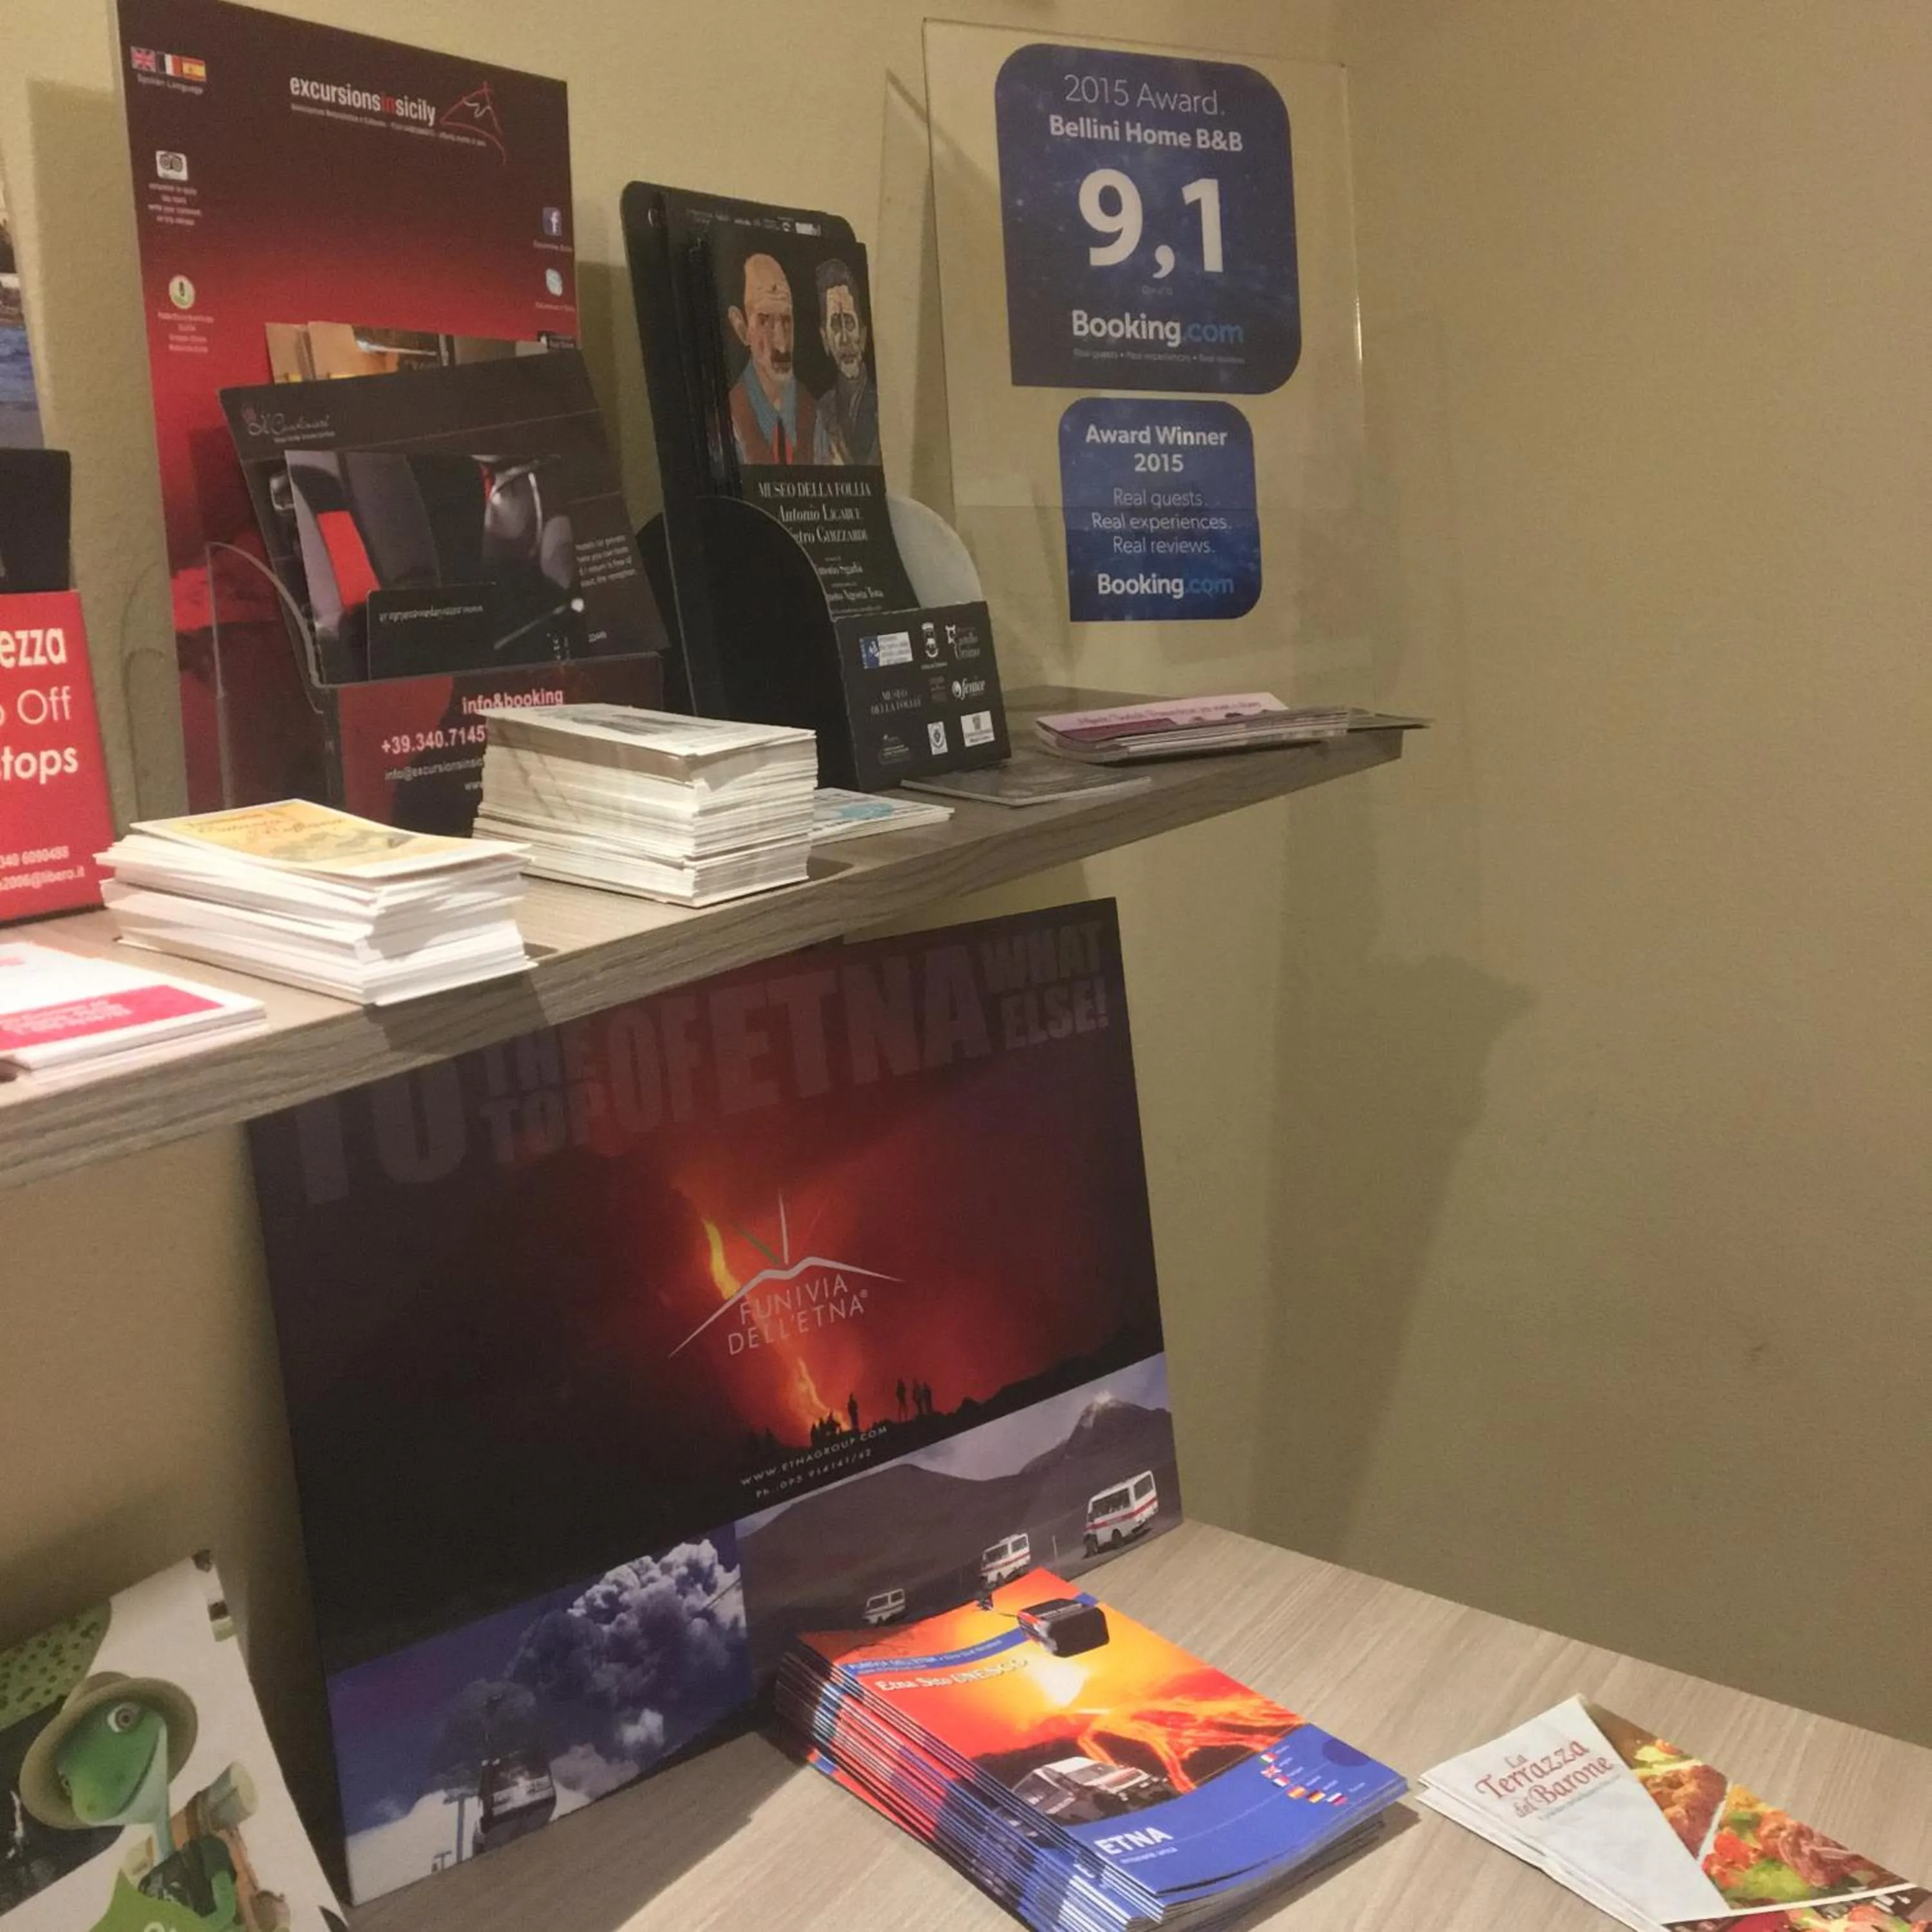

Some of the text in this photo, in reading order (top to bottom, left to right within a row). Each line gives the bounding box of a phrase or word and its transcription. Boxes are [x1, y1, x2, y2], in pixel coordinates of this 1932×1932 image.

[1064, 74, 1129, 107] 2015
[1049, 114, 1244, 152] Bellini Home B&B
[1079, 168, 1223, 279] 9,1
[1072, 309, 1244, 348] Booking.com
[1086, 424, 1227, 446] Award Winner
[1134, 453, 1184, 473] 2015
[1113, 487, 1146, 506] Real
[779, 504, 820, 522] Antonio
[1092, 512, 1125, 530] Real
[1113, 535, 1146, 554] Real
[1097, 573, 1235, 600] Booking.com
[17, 685, 72, 724] Off
[462, 688, 564, 715] info&booking
[381, 724, 486, 755] +39.340.7145
[980, 921, 1106, 992] WHAT
[1001, 974, 1109, 1050] ELSE!
[740, 1273, 848, 1325] FUNIVIA
[1474, 1740, 1591, 1799] Terrazza
[1504, 1754, 1530, 1769] La
[1528, 1757, 1615, 1806] Barone
[1094, 1827, 1174, 1855] ETNA
